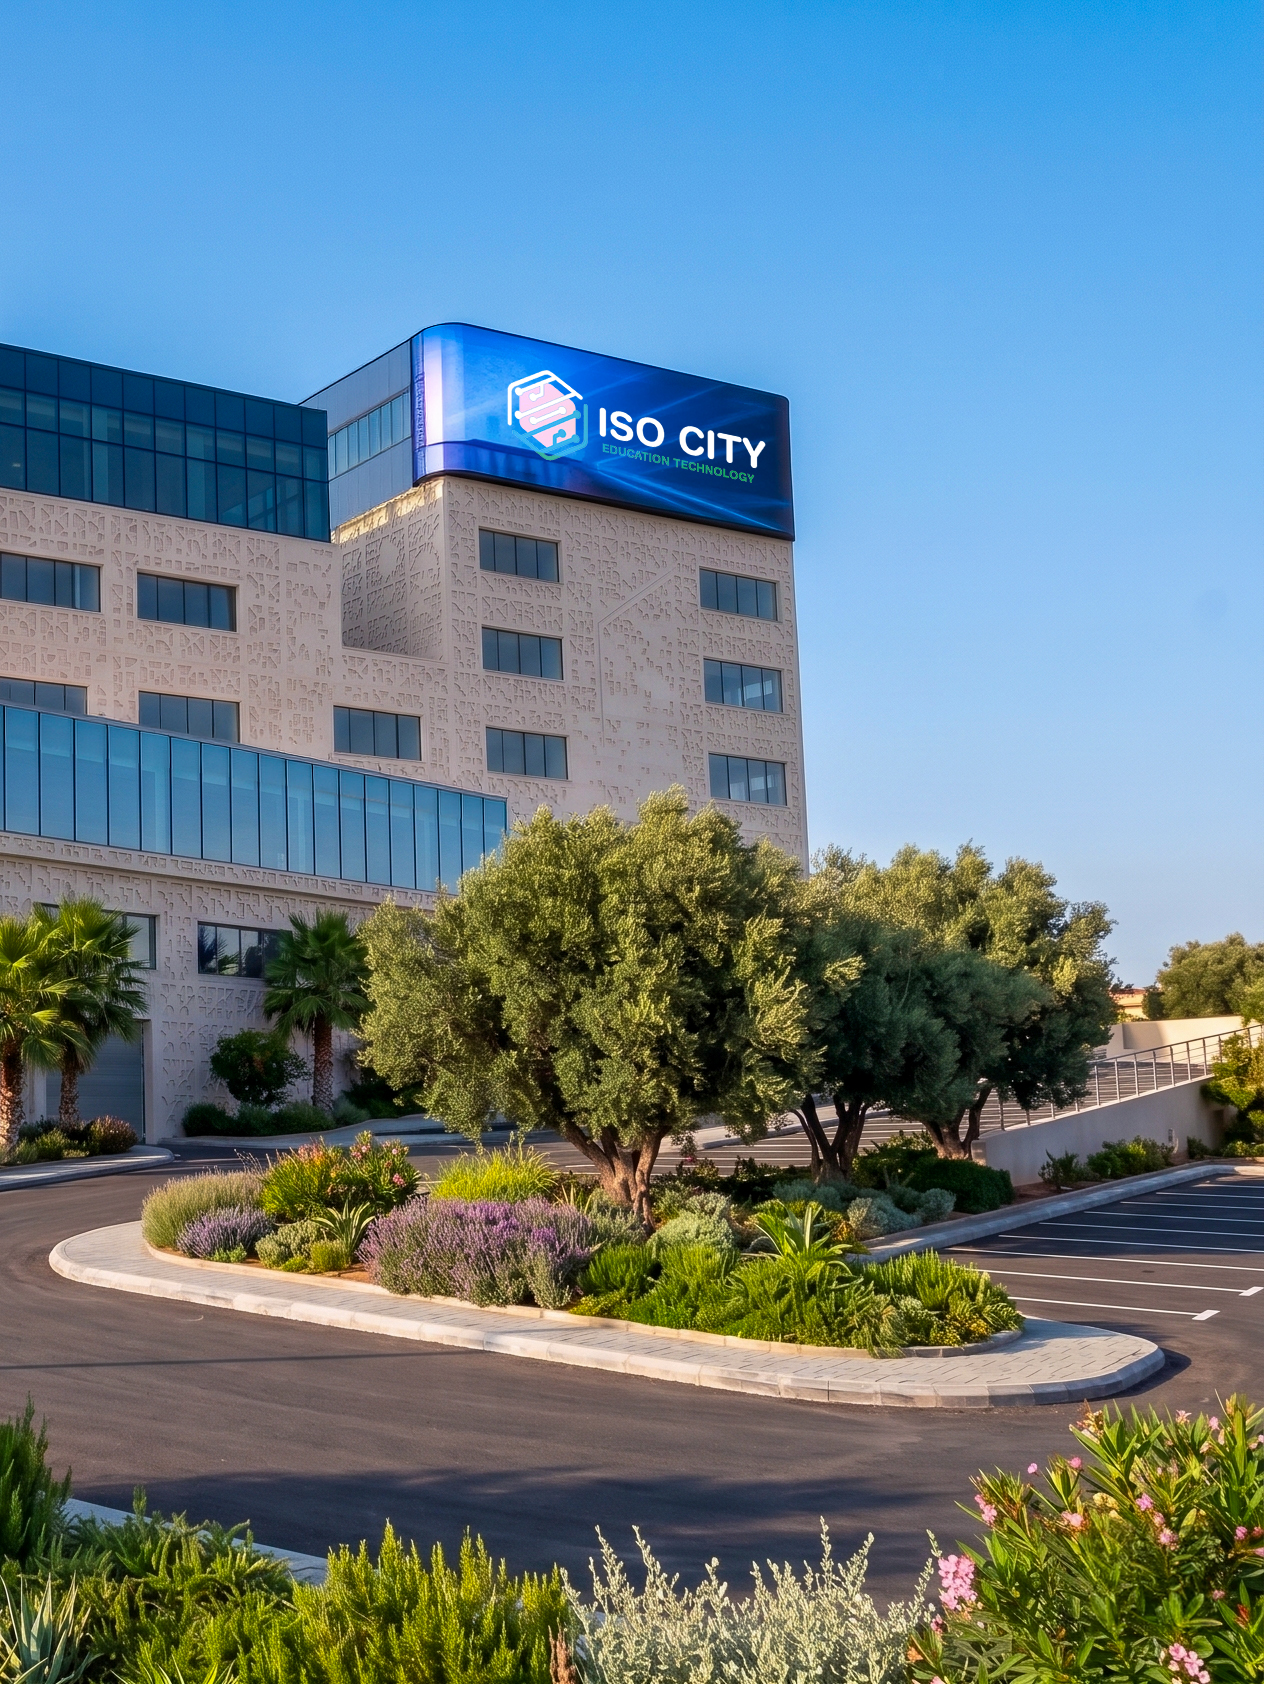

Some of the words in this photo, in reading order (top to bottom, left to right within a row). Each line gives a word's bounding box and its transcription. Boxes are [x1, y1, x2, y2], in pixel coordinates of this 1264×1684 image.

[599, 407, 665, 448] ISO
[679, 425, 766, 469] CITY
[602, 443, 670, 467] EDUCATION
[672, 457, 755, 484] TECHNOLOGY
